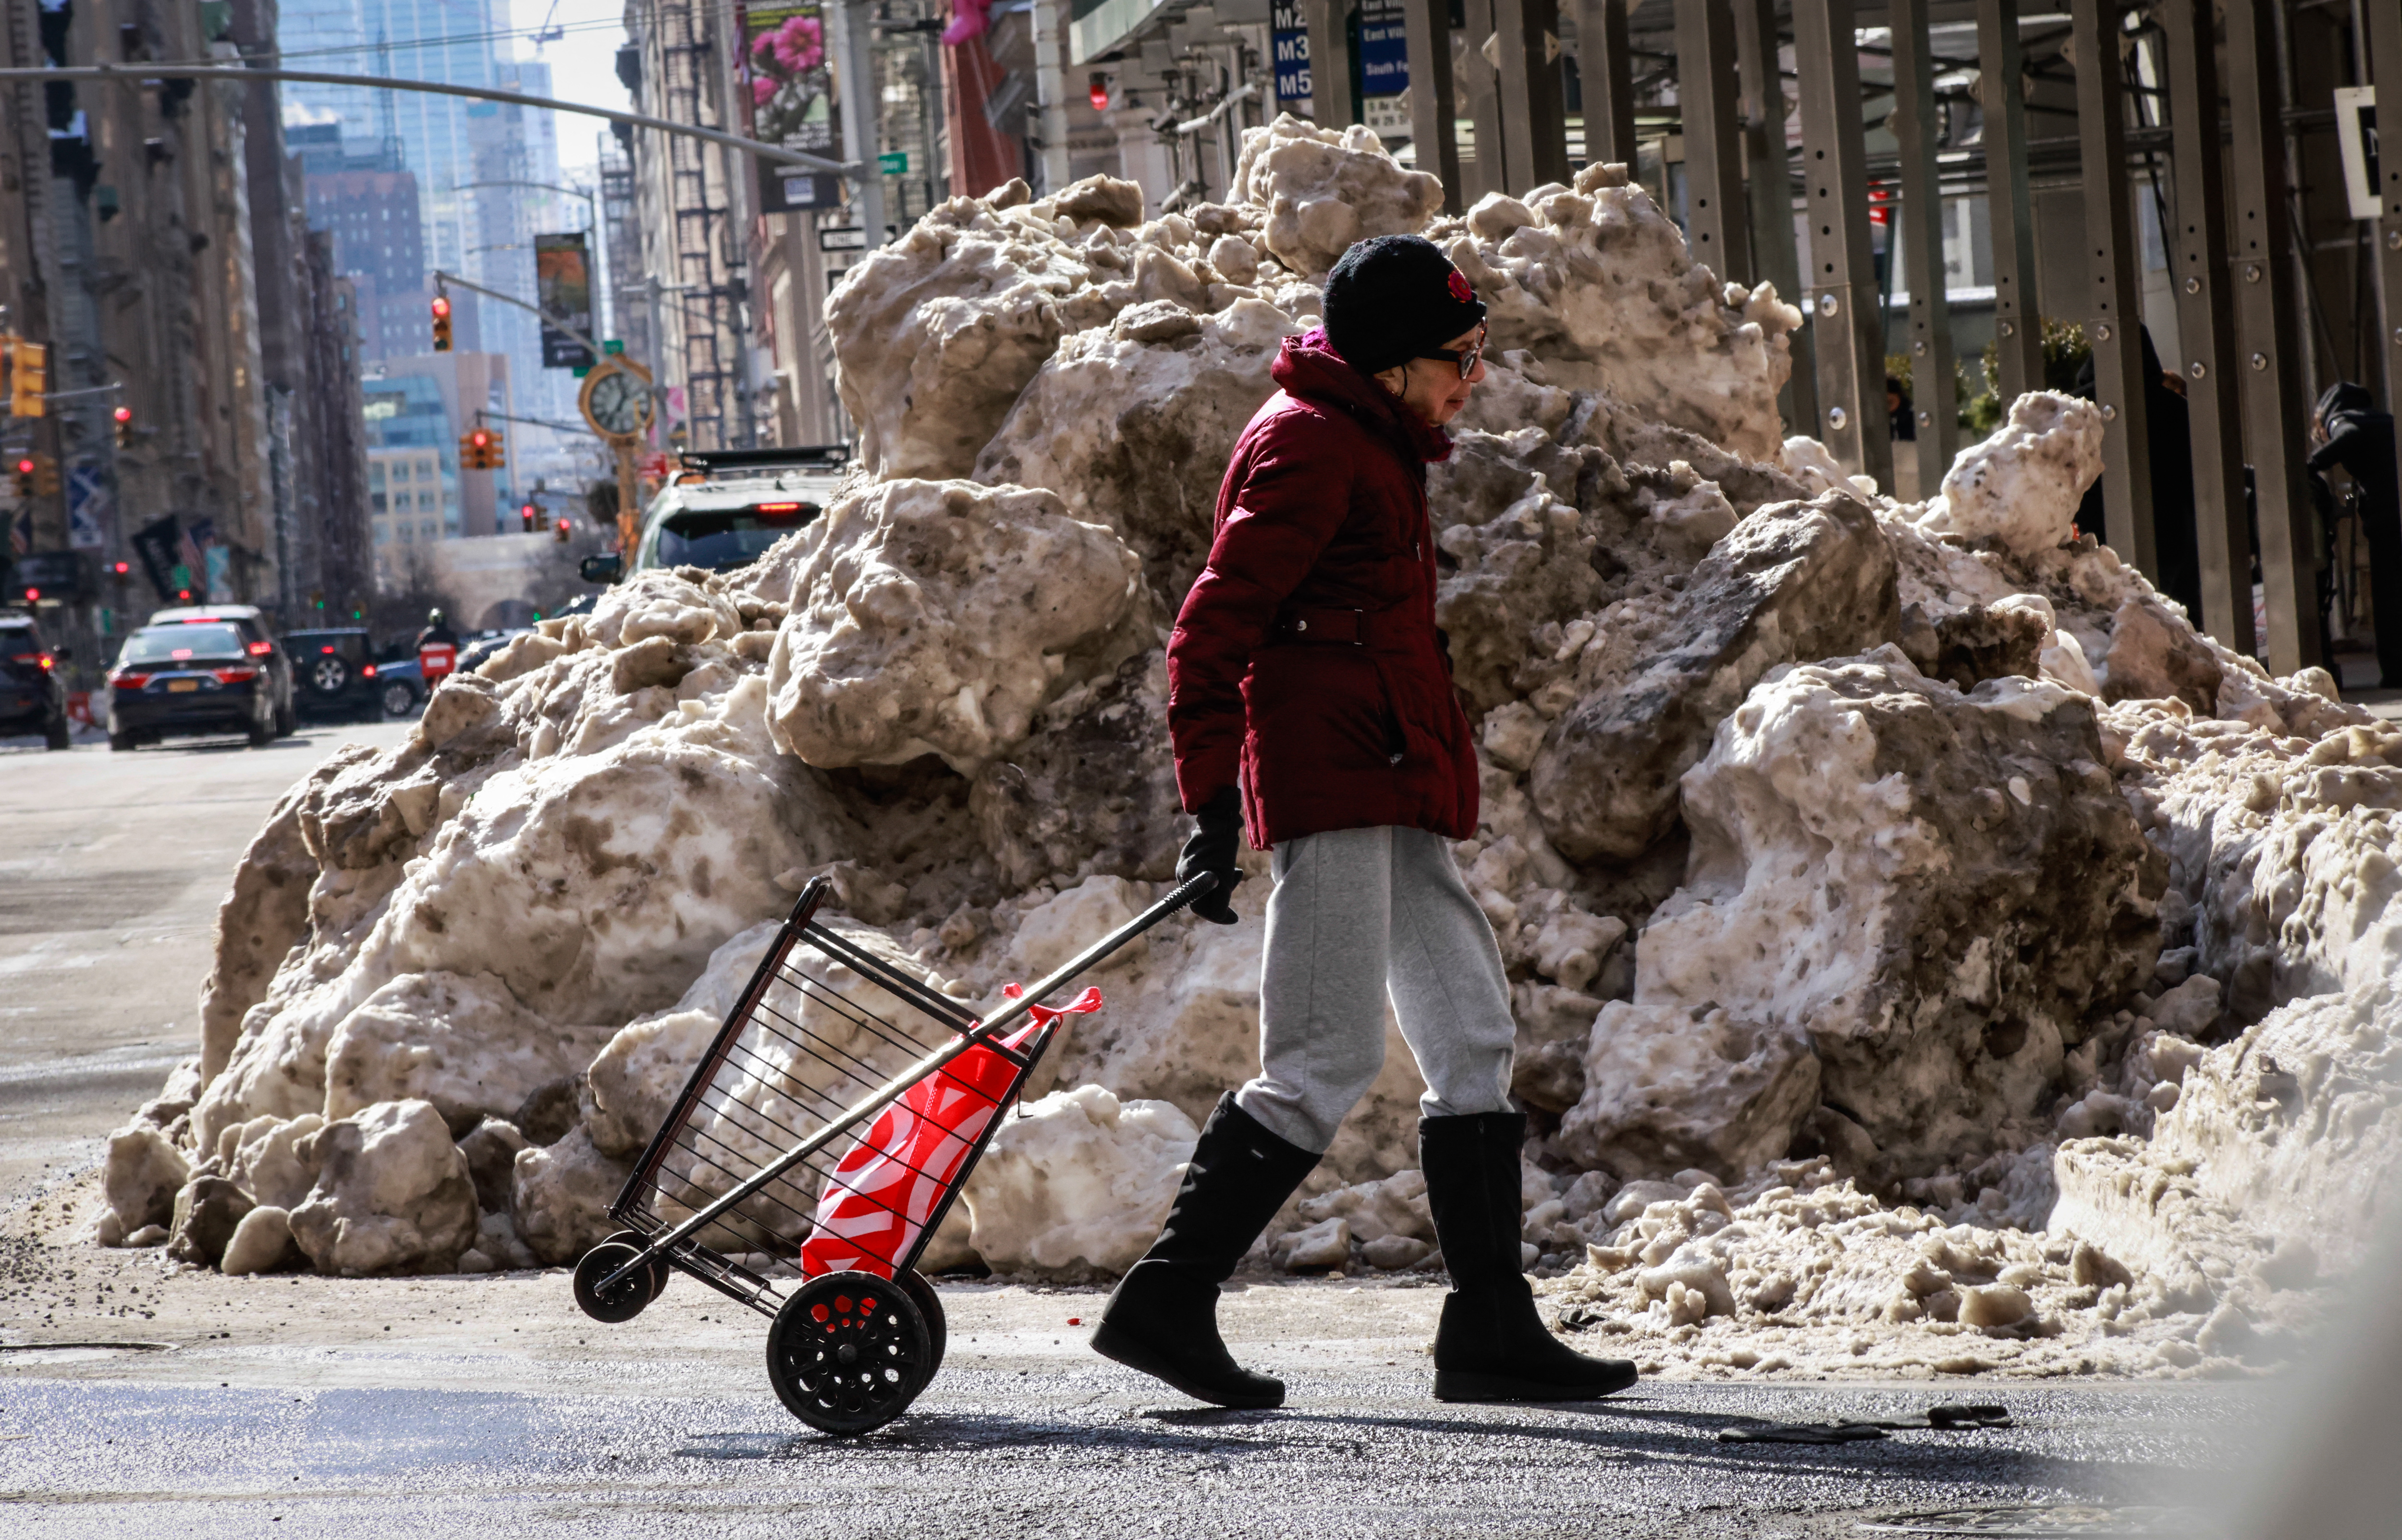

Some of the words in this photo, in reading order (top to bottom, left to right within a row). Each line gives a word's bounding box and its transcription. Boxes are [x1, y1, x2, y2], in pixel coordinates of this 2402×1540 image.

[1363, 28, 1386, 42] East
[1278, 35, 1309, 61] M3
[1366, 61, 1394, 75] South
[1280, 69, 1312, 95] M5
